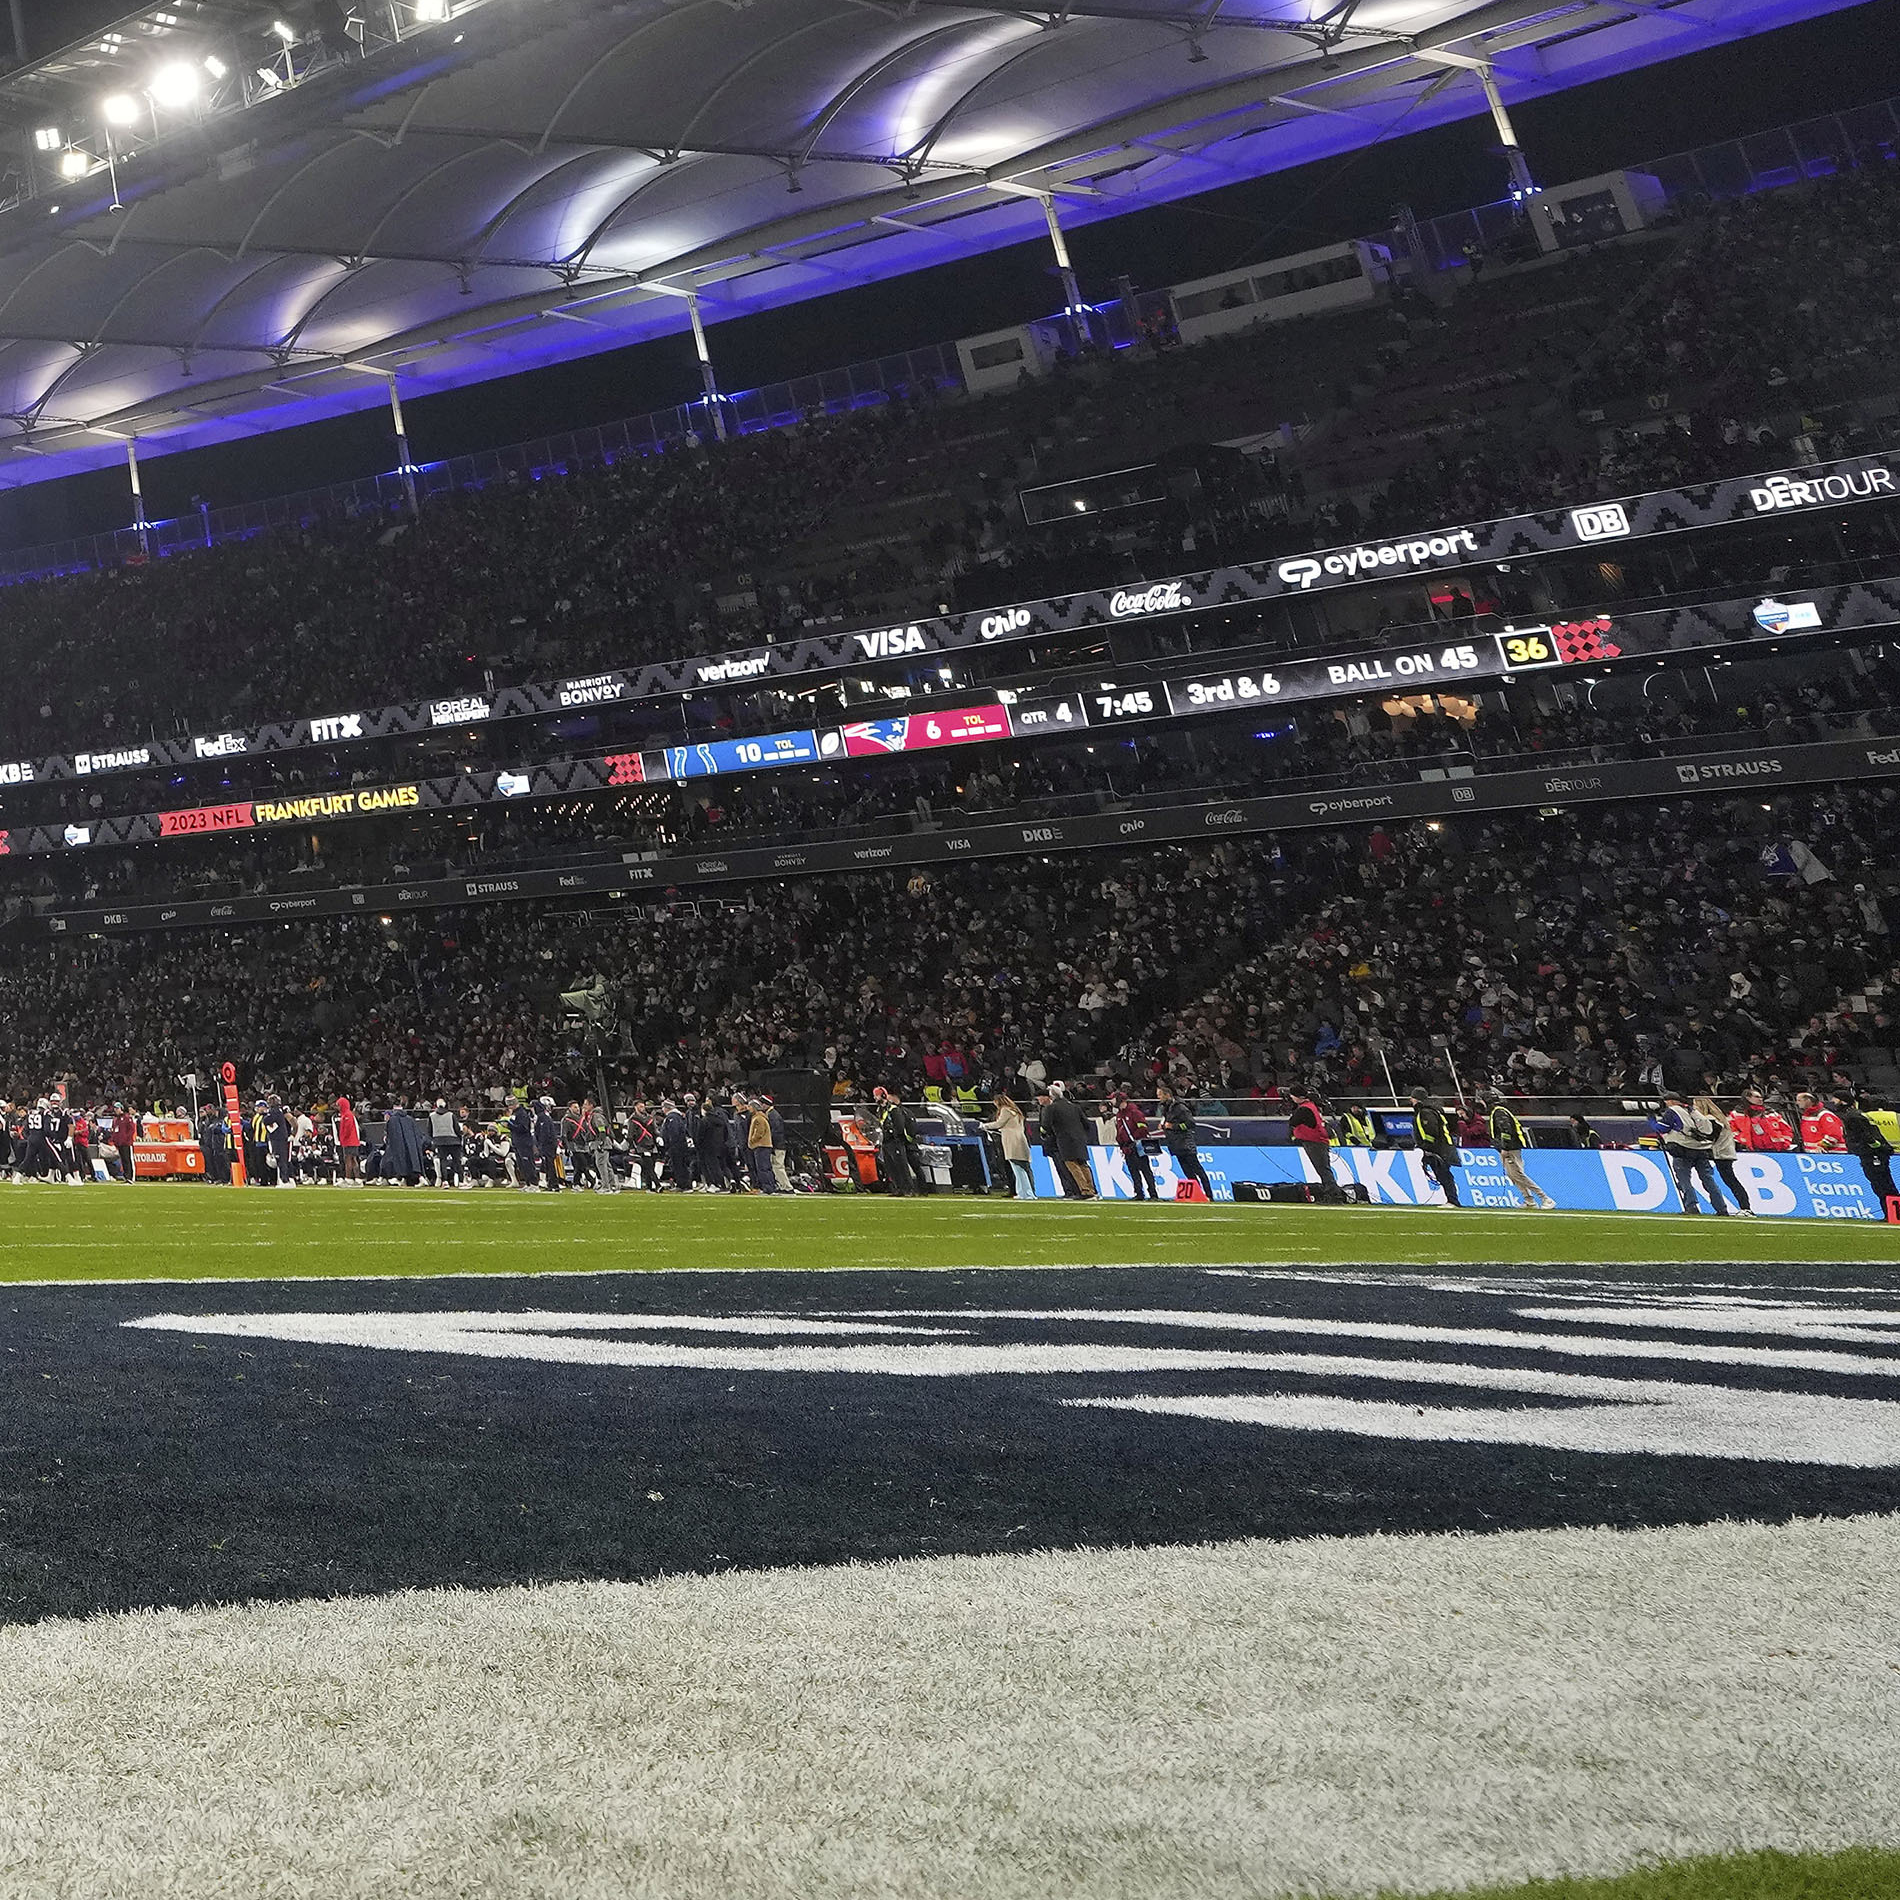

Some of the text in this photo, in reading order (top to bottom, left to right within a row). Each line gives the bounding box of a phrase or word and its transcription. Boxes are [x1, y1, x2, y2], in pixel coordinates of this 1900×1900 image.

[1750, 468, 1896, 512] DERTOUR
[1579, 509, 1621, 536] DB
[1324, 529, 1478, 576] cyberport
[980, 609, 1031, 640] Chio
[853, 626, 927, 658] VISA
[1506, 638, 1549, 662] 36
[698, 658, 764, 683] verizon
[1328, 645, 1479, 685] BALL ON 45
[566, 675, 613, 691] MARRIOTT
[1187, 673, 1281, 705] 3rd & 6
[559, 684, 622, 706] BONVOY
[1096, 691, 1154, 718] 7:45
[432, 708, 490, 726] MEN EXPERT
[1020, 702, 1073, 725] QTR 4
[926, 715, 985, 739] 6 TOL
[194, 734, 247, 758] FedEx
[736, 738, 796, 764] 10 TOL
[91, 749, 150, 770] STRAUSS
[1700, 760, 1783, 780] STRAUSS
[1455, 789, 1472, 801] DB
[1545, 777, 1602, 793] DERTOUR
[169, 786, 420, 831] 2023 NFL FRANKFURT GAMES
[1329, 795, 1394, 812] cyberport
[1022, 828, 1053, 842] DKB
[1119, 818, 1145, 834] Chio
[854, 847, 890, 860] verizon
[946, 839, 972, 851] VISA
[478, 881, 519, 893] STRAUSS
[280, 898, 316, 910] cyberport
[28, 1114, 43, 1130] 59
[186, 1153, 196, 1168] G
[1461, 1150, 1497, 1167] Das
[1799, 1154, 1845, 1174] Das
[1466, 1170, 1515, 1187] kann
[1802, 1176, 1864, 1197] kann
[1177, 1181, 1194, 1200] 20
[1472, 1189, 1522, 1208] Bank
[1811, 1198, 1875, 1220] Bank
